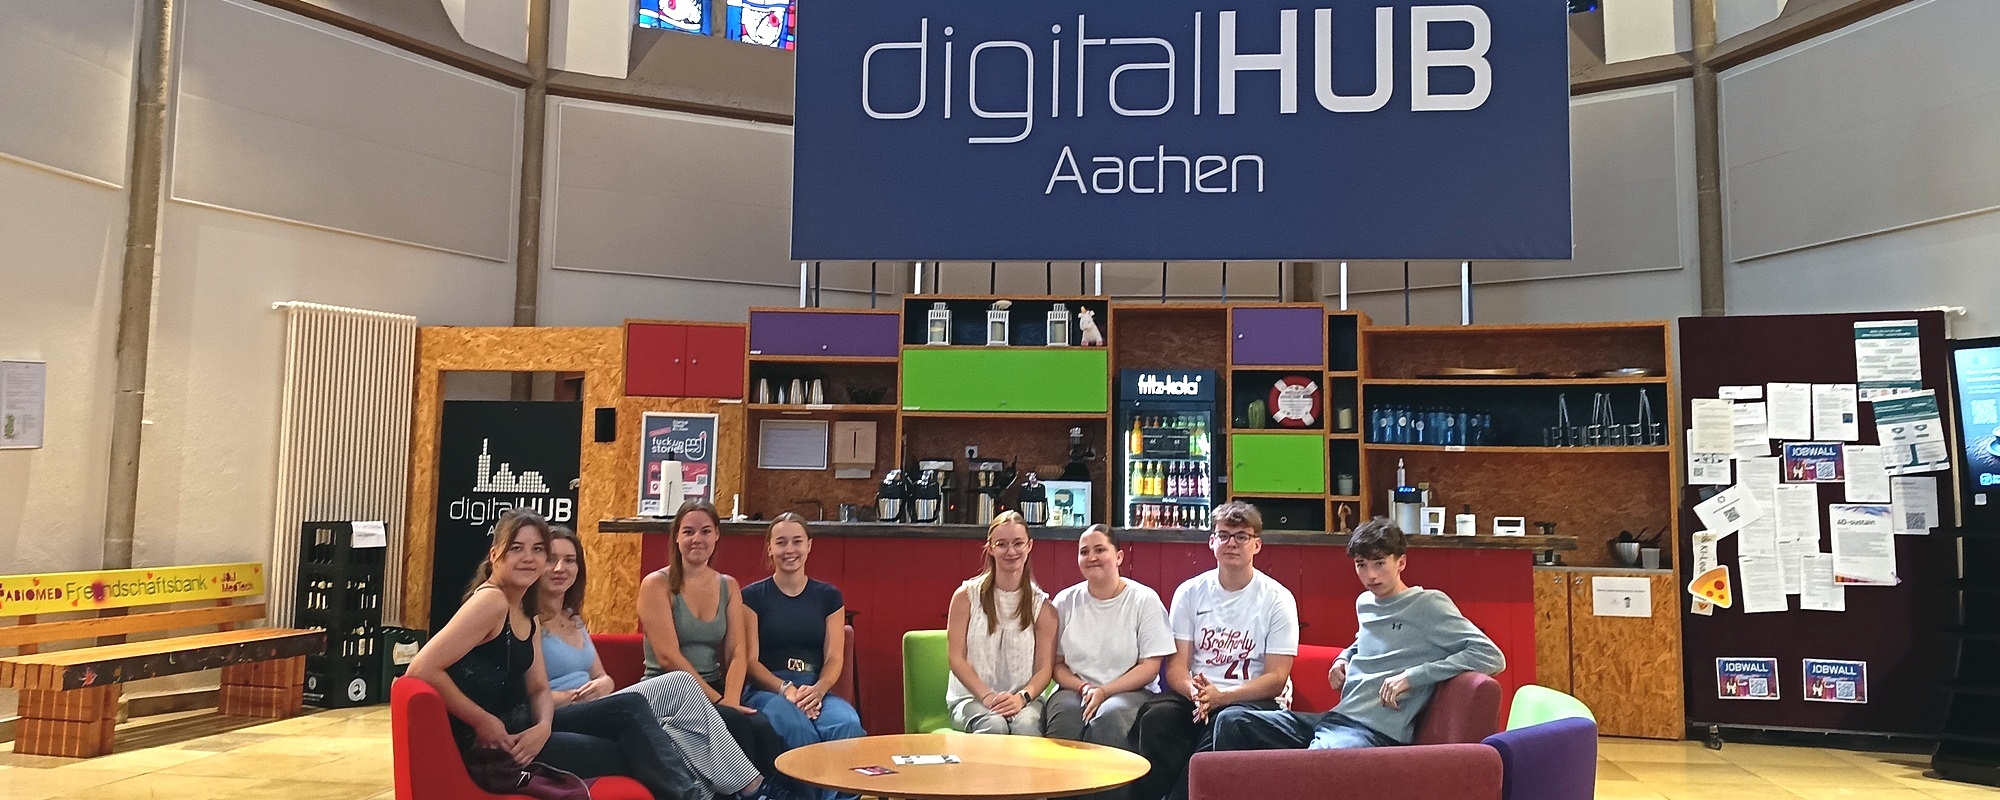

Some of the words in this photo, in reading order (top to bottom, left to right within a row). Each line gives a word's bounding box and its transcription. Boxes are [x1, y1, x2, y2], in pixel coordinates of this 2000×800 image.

[862, 5, 1492, 144] digitalHUB
[1045, 146, 1265, 194] Aachen
[1792, 447, 1836, 456] JOBWALL
[5, 588, 62, 602] ABIOMED
[66, 575, 207, 601] Frendschaftsbank
[222, 582, 254, 593] MedTech
[1199, 627, 1257, 660] Brotherly
[1224, 659, 1251, 680] 21
[1725, 663, 1769, 672] JOBWALL
[1812, 664, 1857, 675] JOBWALL
